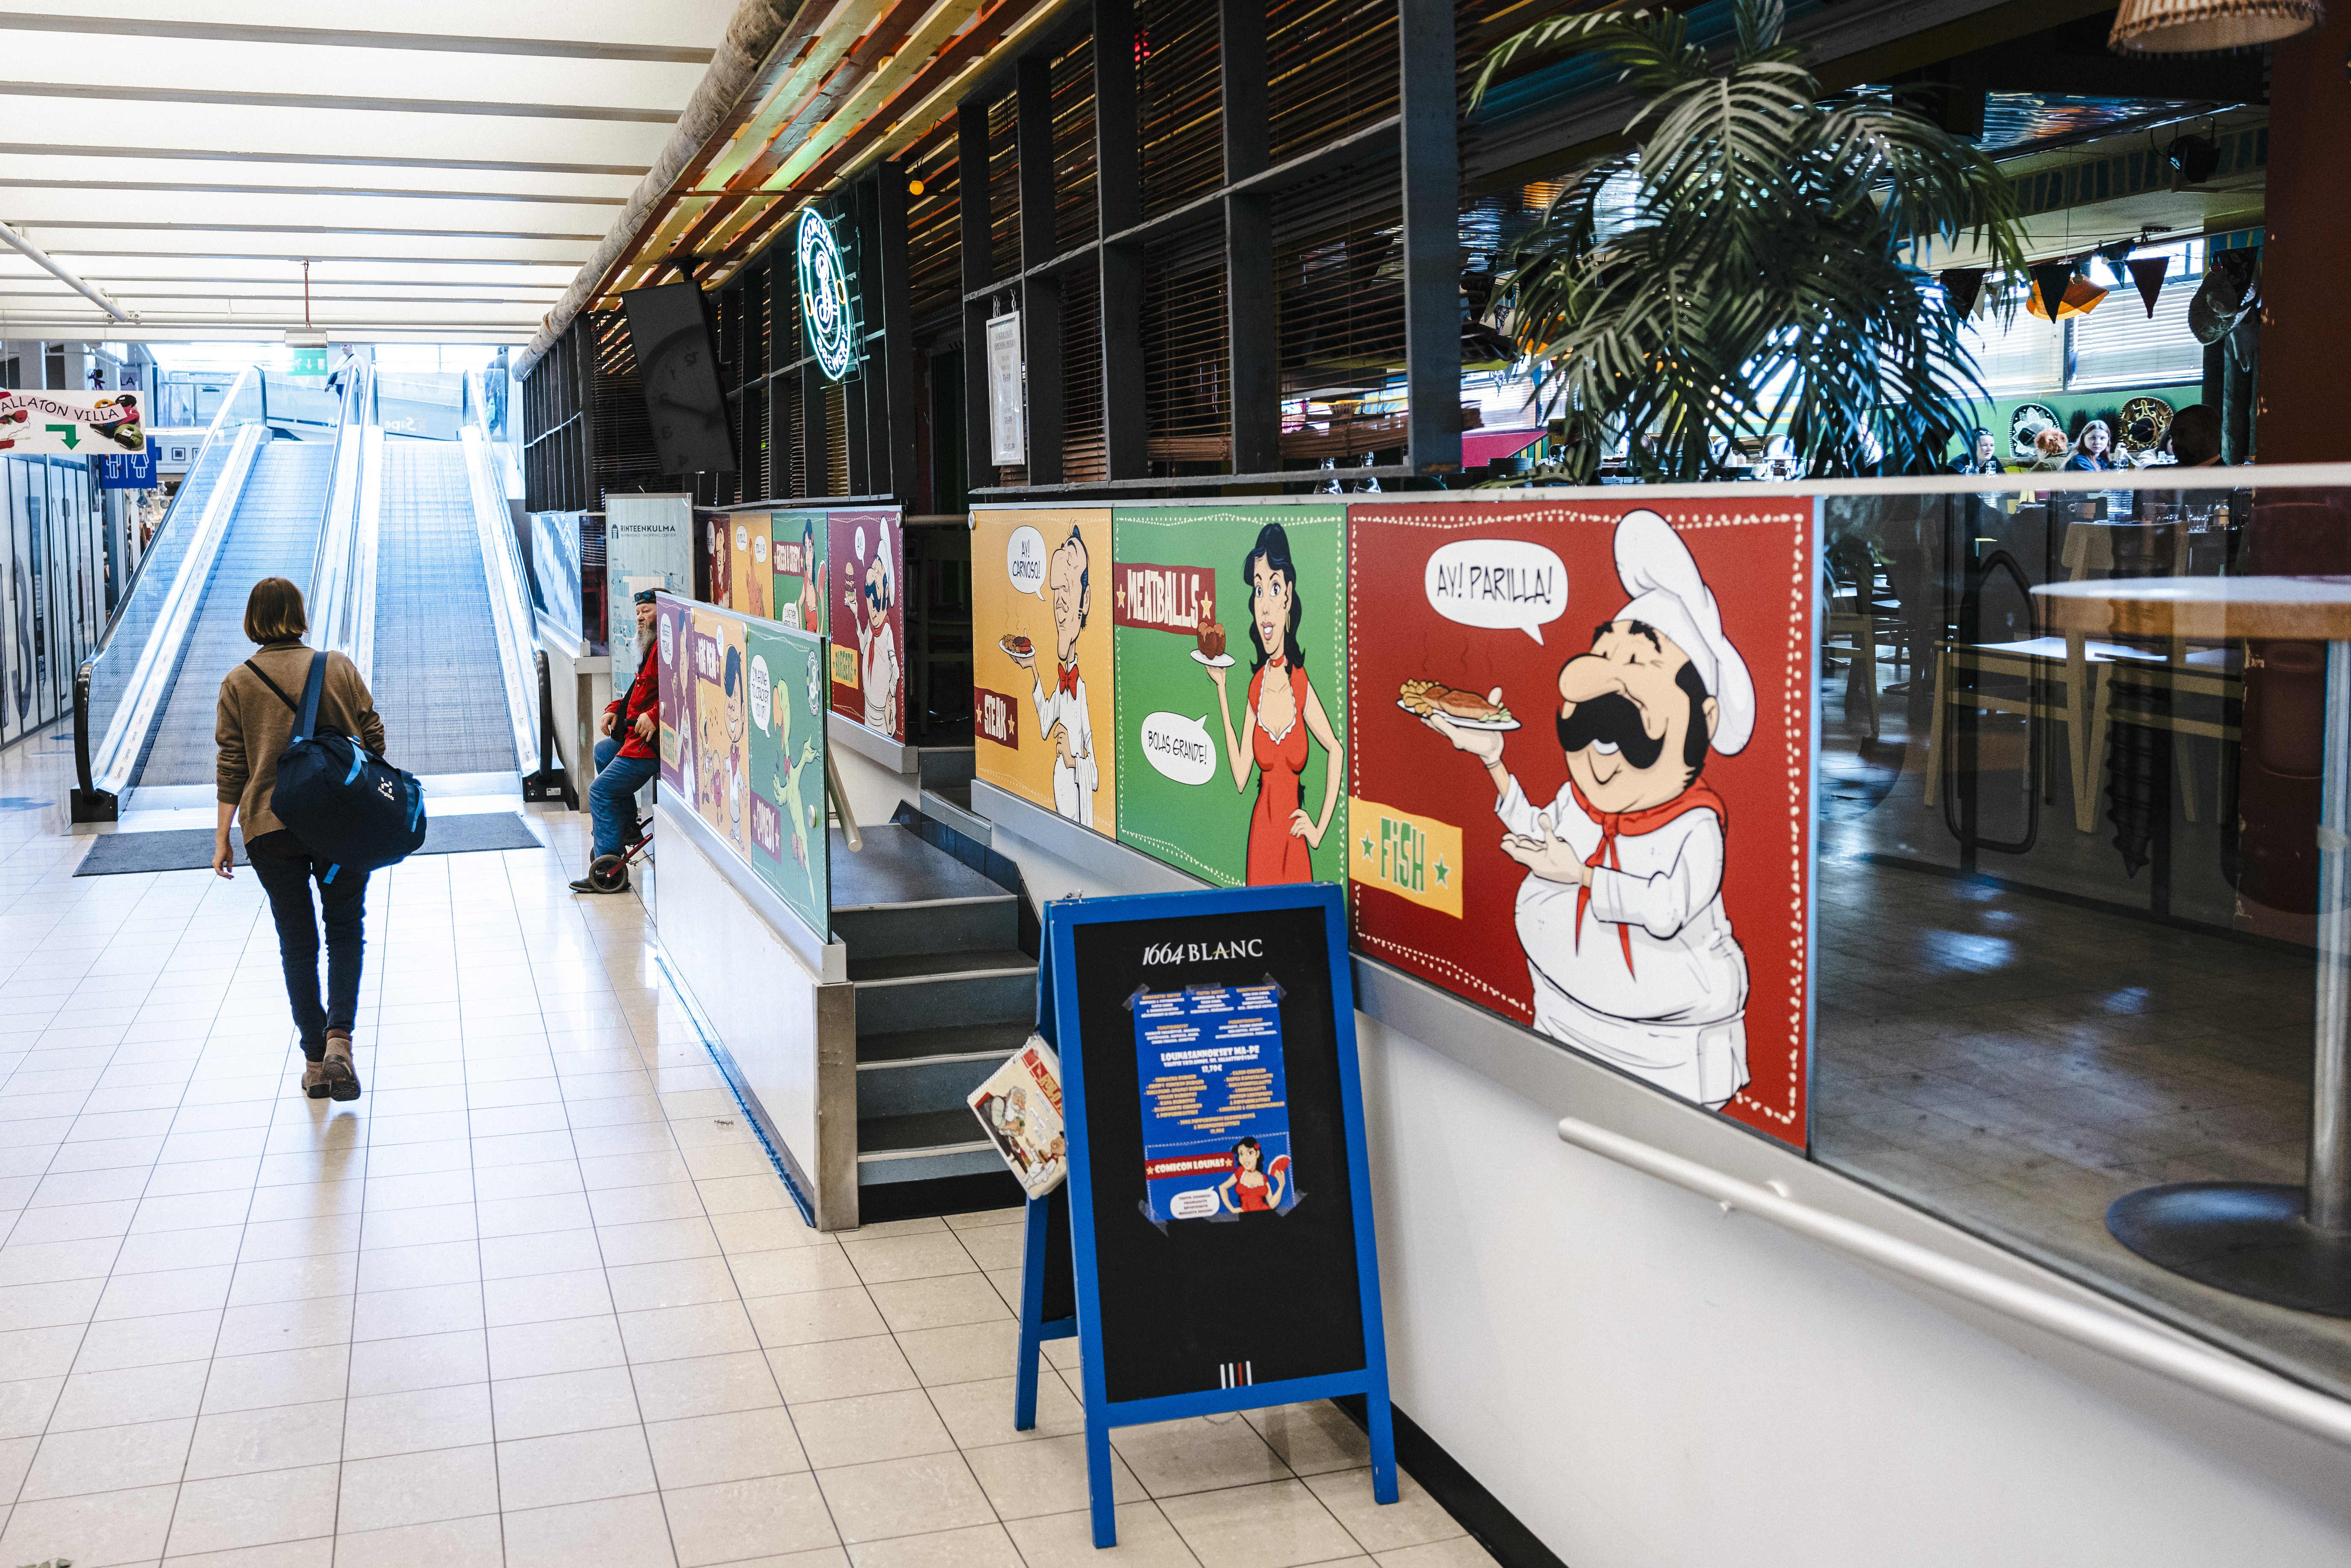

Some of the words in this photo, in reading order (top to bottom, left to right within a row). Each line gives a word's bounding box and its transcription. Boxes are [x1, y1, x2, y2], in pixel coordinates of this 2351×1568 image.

[994, 342, 1006, 350] OPENING
[74, 409, 119, 421] VILLA
[777, 544, 787, 572] GREEN
[1021, 541, 1030, 559] AY!
[1012, 560, 1040, 580] CARNOSO!
[1437, 562, 1463, 599] AY!
[1470, 565, 1553, 605] PARILLA!
[1127, 569, 1199, 629] MEATBALLS
[706, 640, 716, 680] MENU
[835, 650, 854, 683] BURGERS
[757, 669, 767, 686] GOING
[756, 686, 769, 704] CRACKER
[984, 694, 1007, 742] STEAK
[1148, 730, 1170, 752] BOLAS
[1173, 737, 1207, 765] GRANDE!
[757, 799, 775, 853] COMEDY
[1143, 942, 1185, 965] 1664
[1187, 939, 1263, 961] BLANC
[1155, 1161, 1193, 1174] COMICON
[1193, 1158, 1225, 1170] LOUNAS
